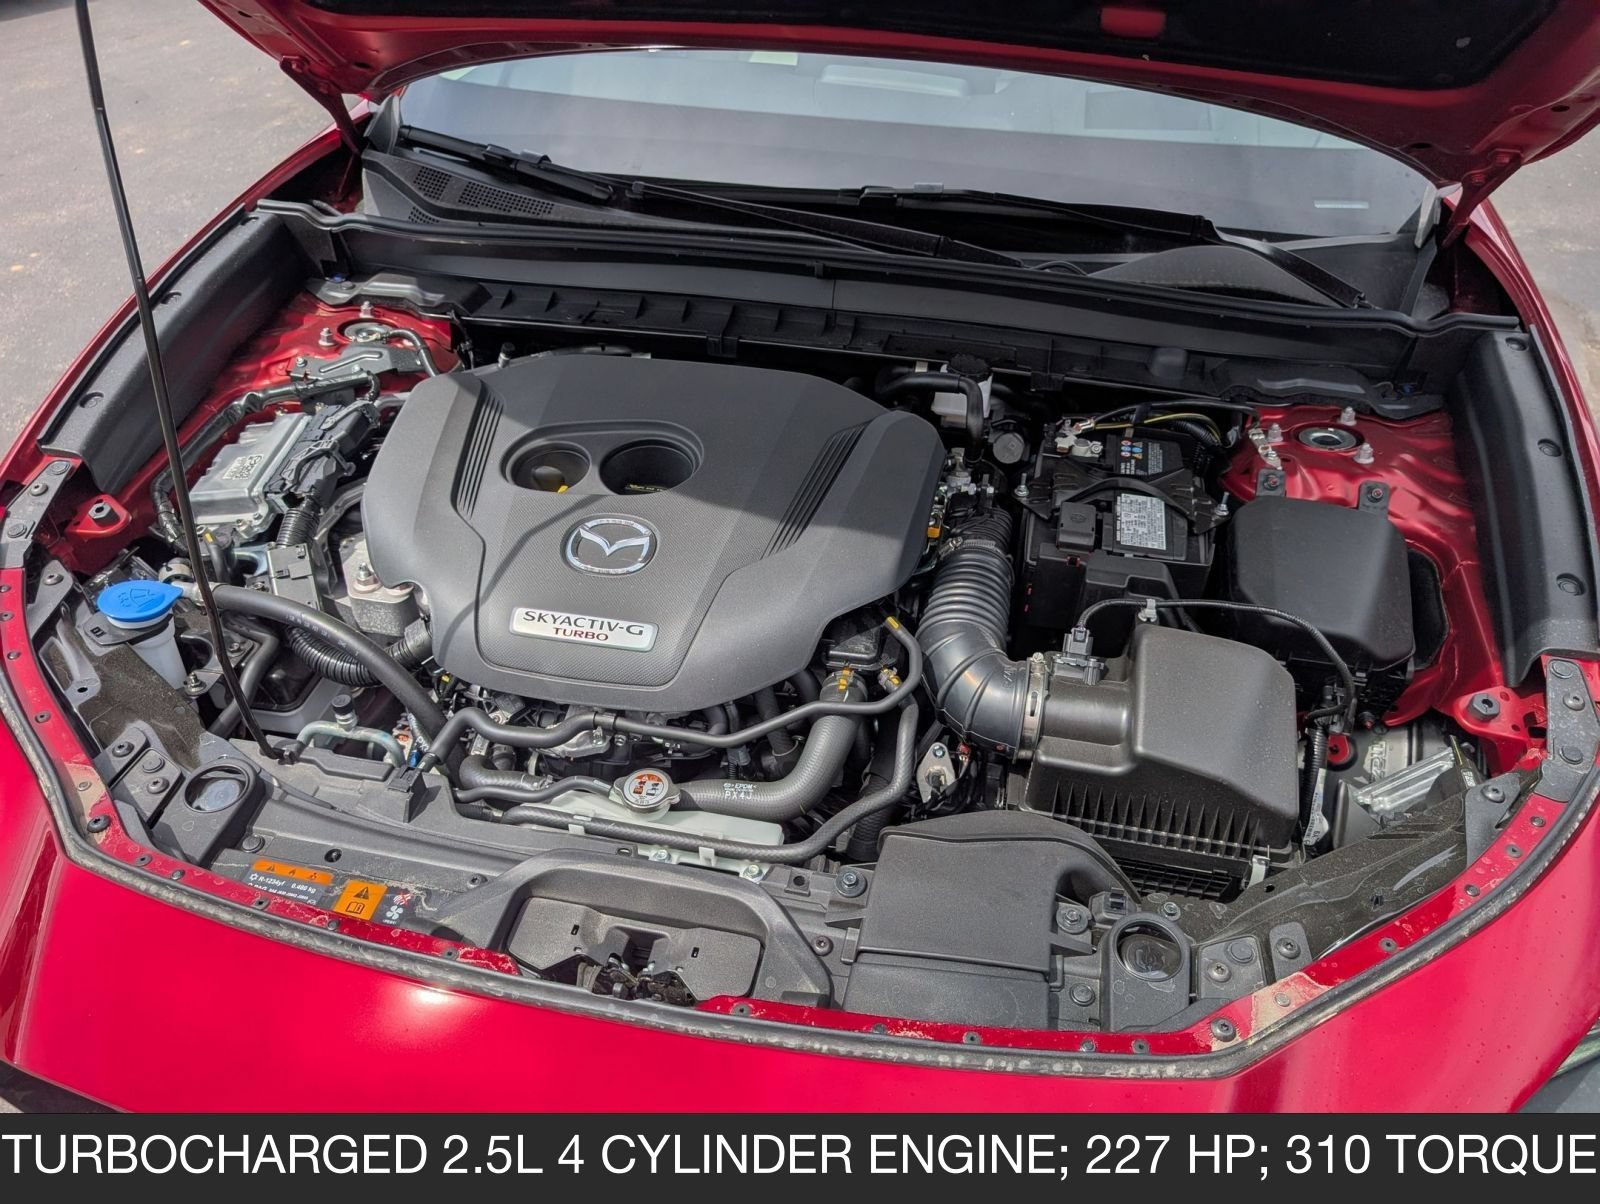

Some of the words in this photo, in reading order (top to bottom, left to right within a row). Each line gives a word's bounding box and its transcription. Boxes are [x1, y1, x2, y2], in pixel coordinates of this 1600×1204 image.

[523, 610, 645, 636] SKYACTIV-G
[553, 627, 609, 641] TURBO
[258, 876, 285, 886] R-1234yf
